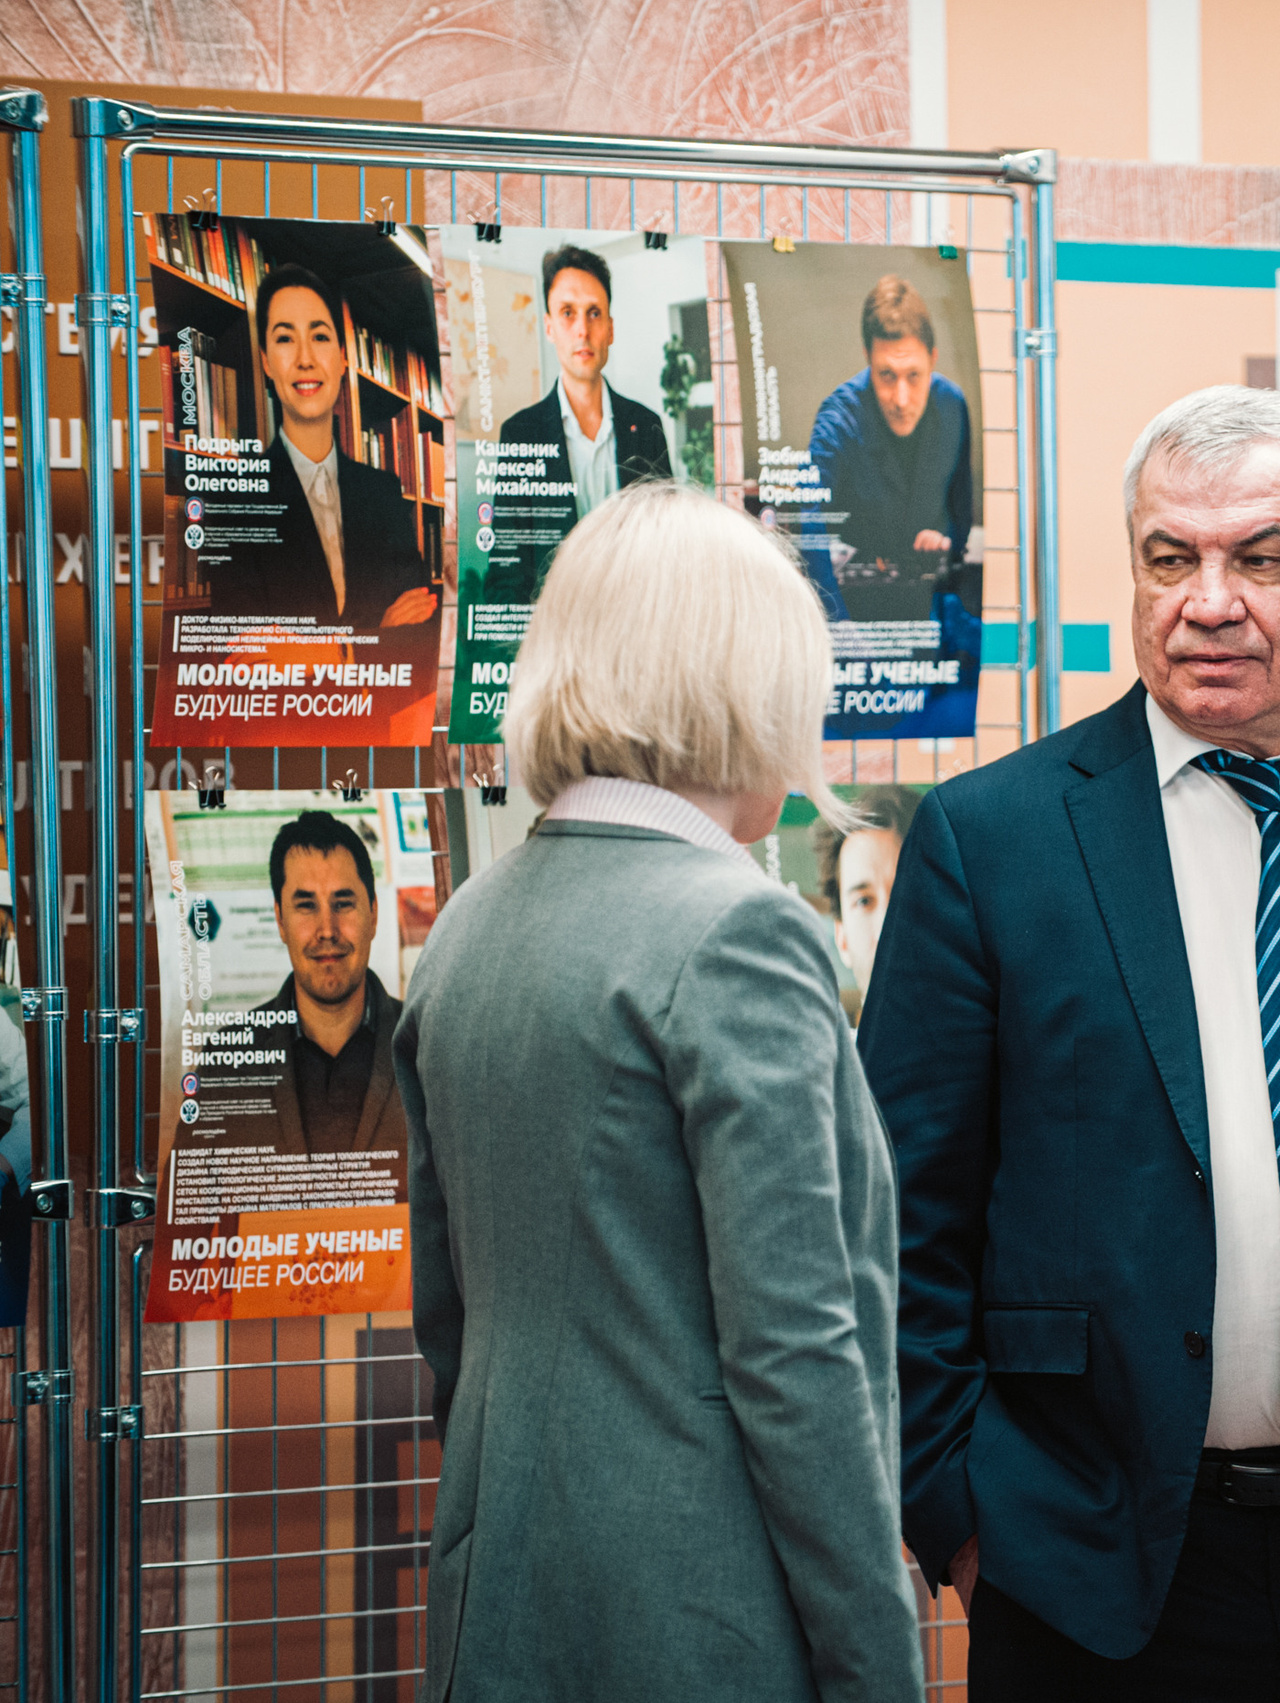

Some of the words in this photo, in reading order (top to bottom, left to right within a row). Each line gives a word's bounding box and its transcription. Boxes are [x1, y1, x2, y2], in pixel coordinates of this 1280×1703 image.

[177, 326, 197, 425] МОСКВА
[185, 434, 263, 456] Подрыга
[475, 440, 560, 458] Кашевник
[185, 454, 270, 476] Виктория
[476, 459, 546, 477] Алексей
[759, 465, 820, 486] Андрей
[185, 474, 270, 493] Олеговна
[476, 478, 578, 496] Михайлович
[759, 485, 832, 507] Юрьевич
[181, 616, 208, 624] ДОКТОР
[181, 625, 228, 634] РАЗРАБОТАЛА
[230, 625, 274, 634] ТЕХНОЛОГИЮ
[177, 663, 306, 690] МОЛОДЫЕ
[312, 664, 413, 687] УЧЕНЫЕ
[870, 661, 960, 685] УЧЕНЫЕ
[174, 694, 278, 721] БУДУЩЕЕ
[283, 694, 372, 717] РОССИИ
[844, 690, 926, 714] РОССИИ
[170, 861, 194, 1001] САМАРСКАЯ
[195, 893, 213, 1000] ОБЛАСТЬ
[181, 1010, 298, 1028] Александров
[182, 1029, 253, 1046] Евгений
[182, 1049, 286, 1070] Викторович
[206, 1157, 228, 1166] НОВОЕ
[229, 1156, 260, 1164] НАУЧНОЕ
[171, 1233, 299, 1262] МОЛОДЫЕ
[305, 1228, 404, 1255] УЧЕНЫЕ
[169, 1265, 270, 1294] БУДУЩЕЕ
[276, 1260, 364, 1287] РОССИИ
